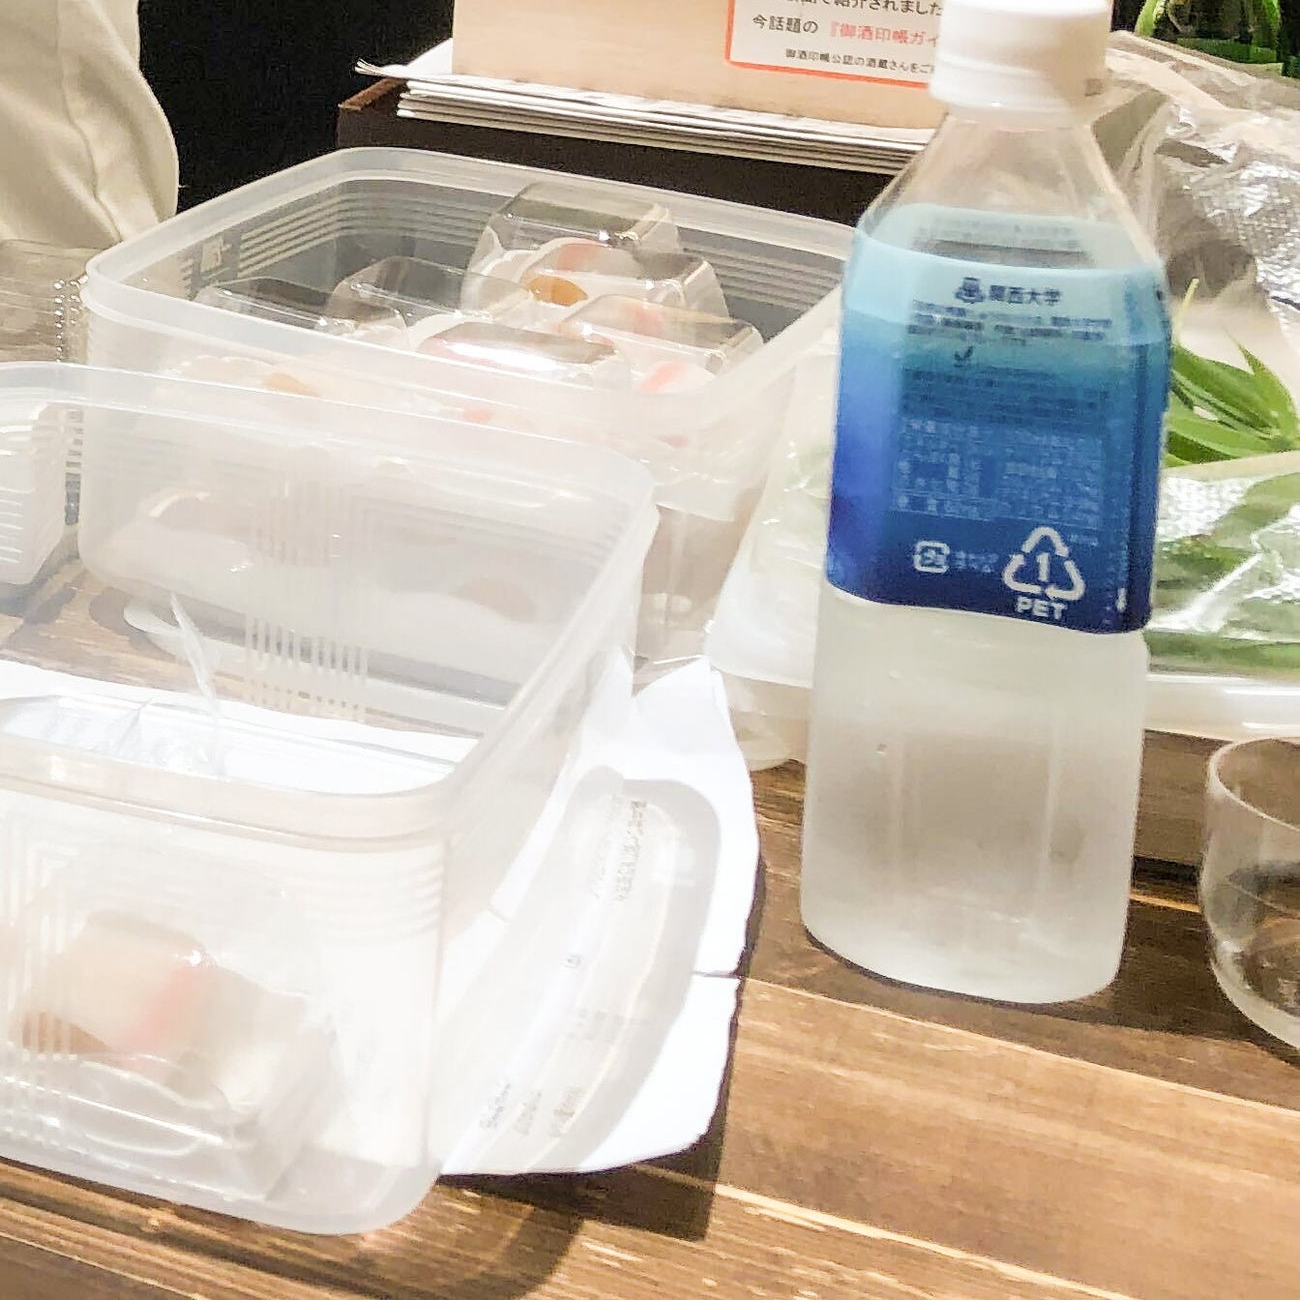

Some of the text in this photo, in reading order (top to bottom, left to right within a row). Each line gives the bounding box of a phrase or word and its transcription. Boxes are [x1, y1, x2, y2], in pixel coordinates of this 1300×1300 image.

[752, 13, 819, 35] 今話題の
[1016, 595, 1068, 620] PET
